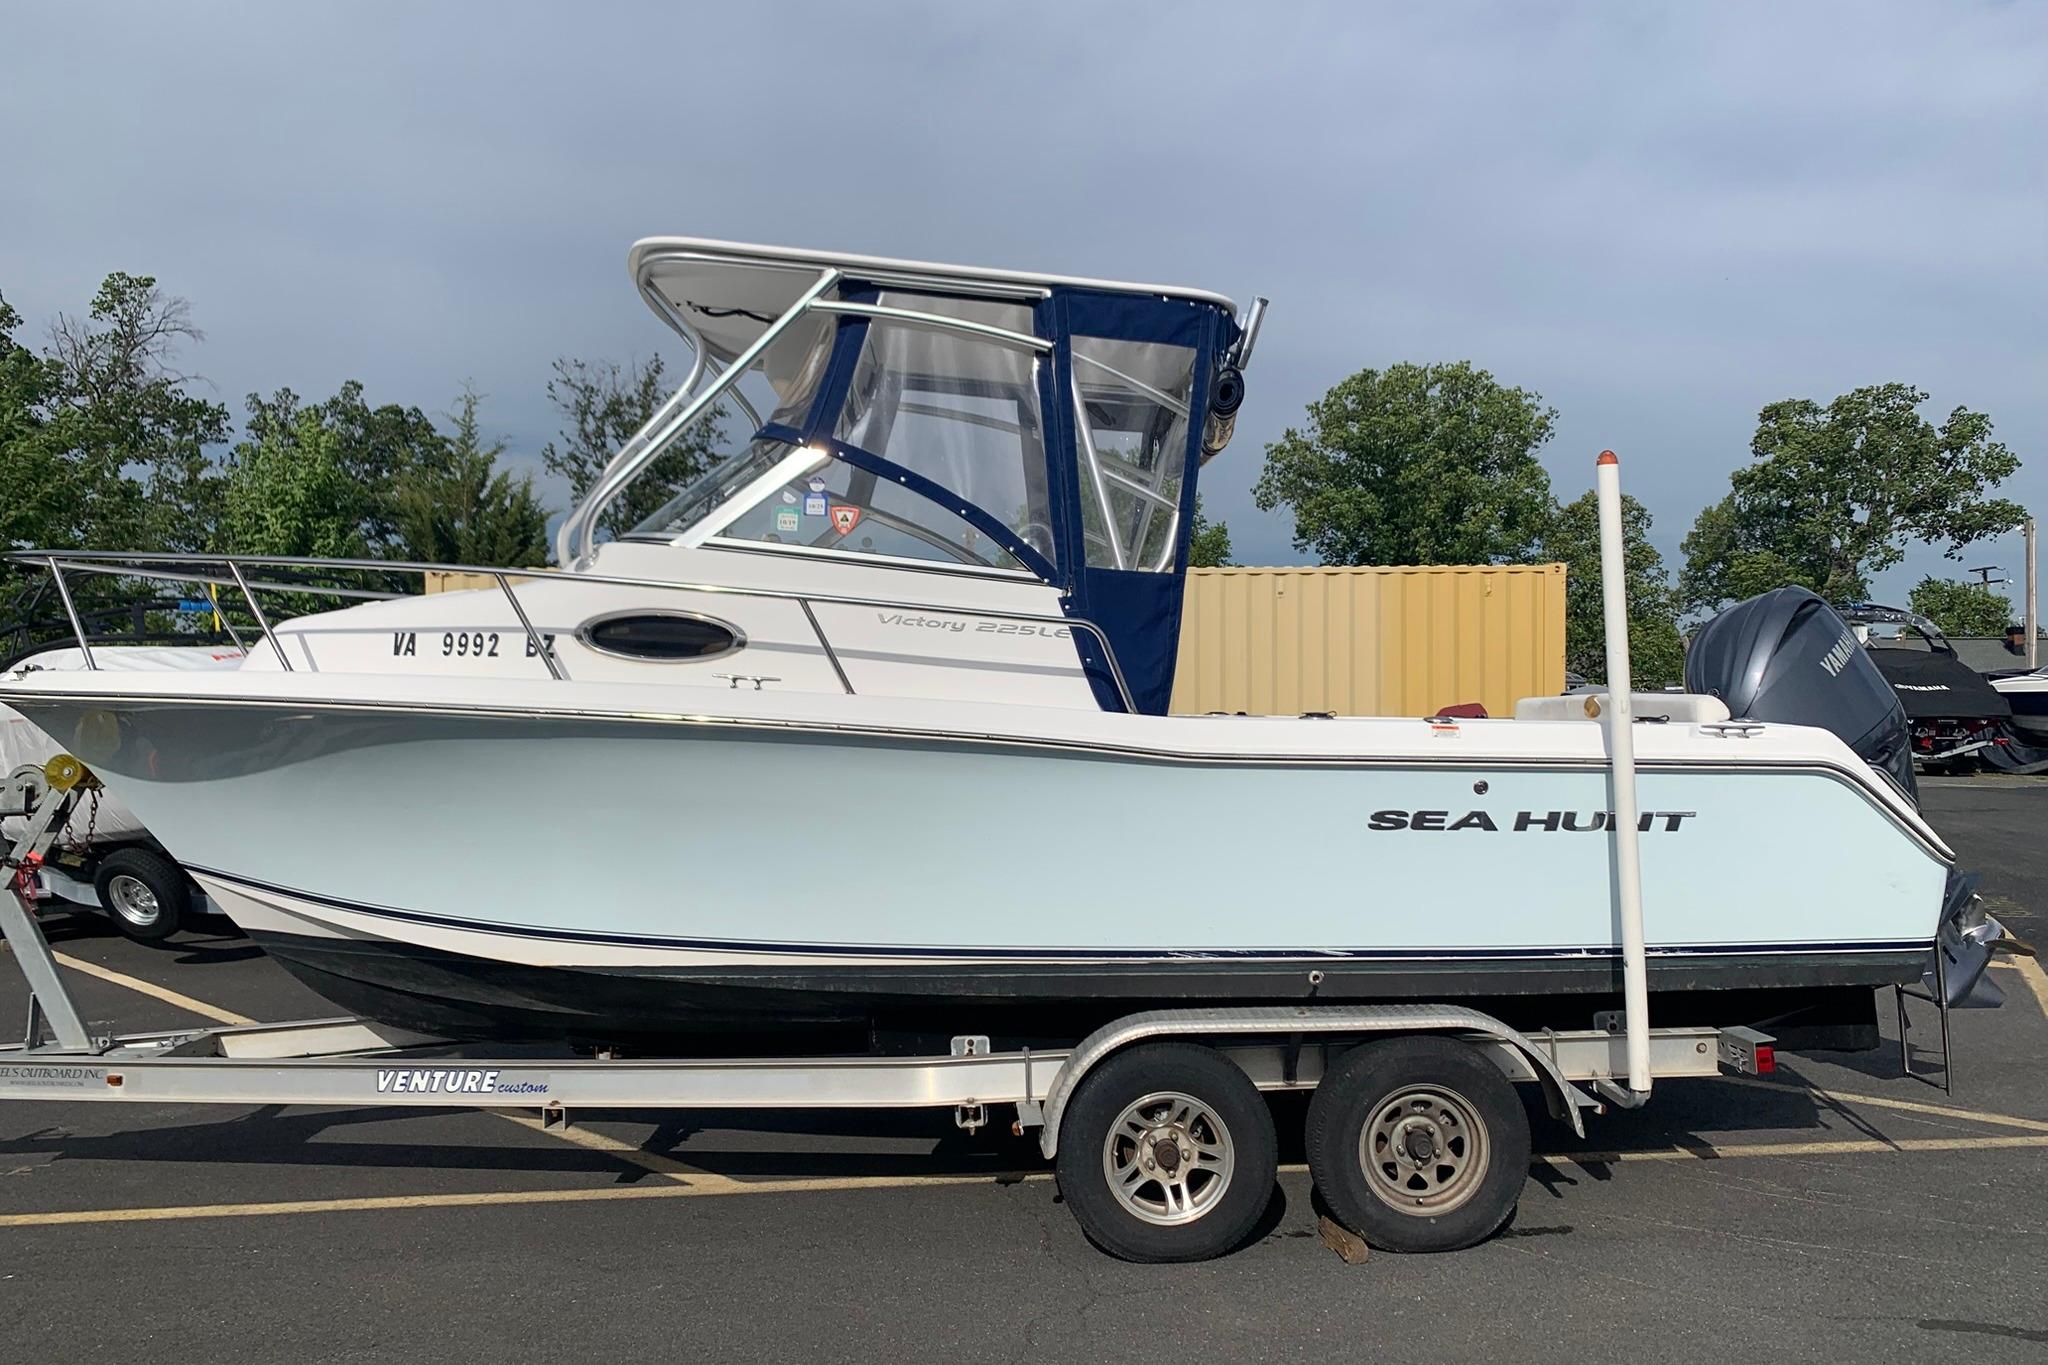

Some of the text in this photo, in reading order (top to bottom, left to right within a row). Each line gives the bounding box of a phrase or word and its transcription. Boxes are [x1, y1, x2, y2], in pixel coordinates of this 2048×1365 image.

[877, 613, 967, 632] Victory
[393, 632, 417, 657] VA
[442, 632, 500, 657] 9992
[1367, 810, 1499, 832] SEA
[20, 1068, 82, 1079] OUTBOARD
[376, 1069, 549, 1094] VENTURE custom
